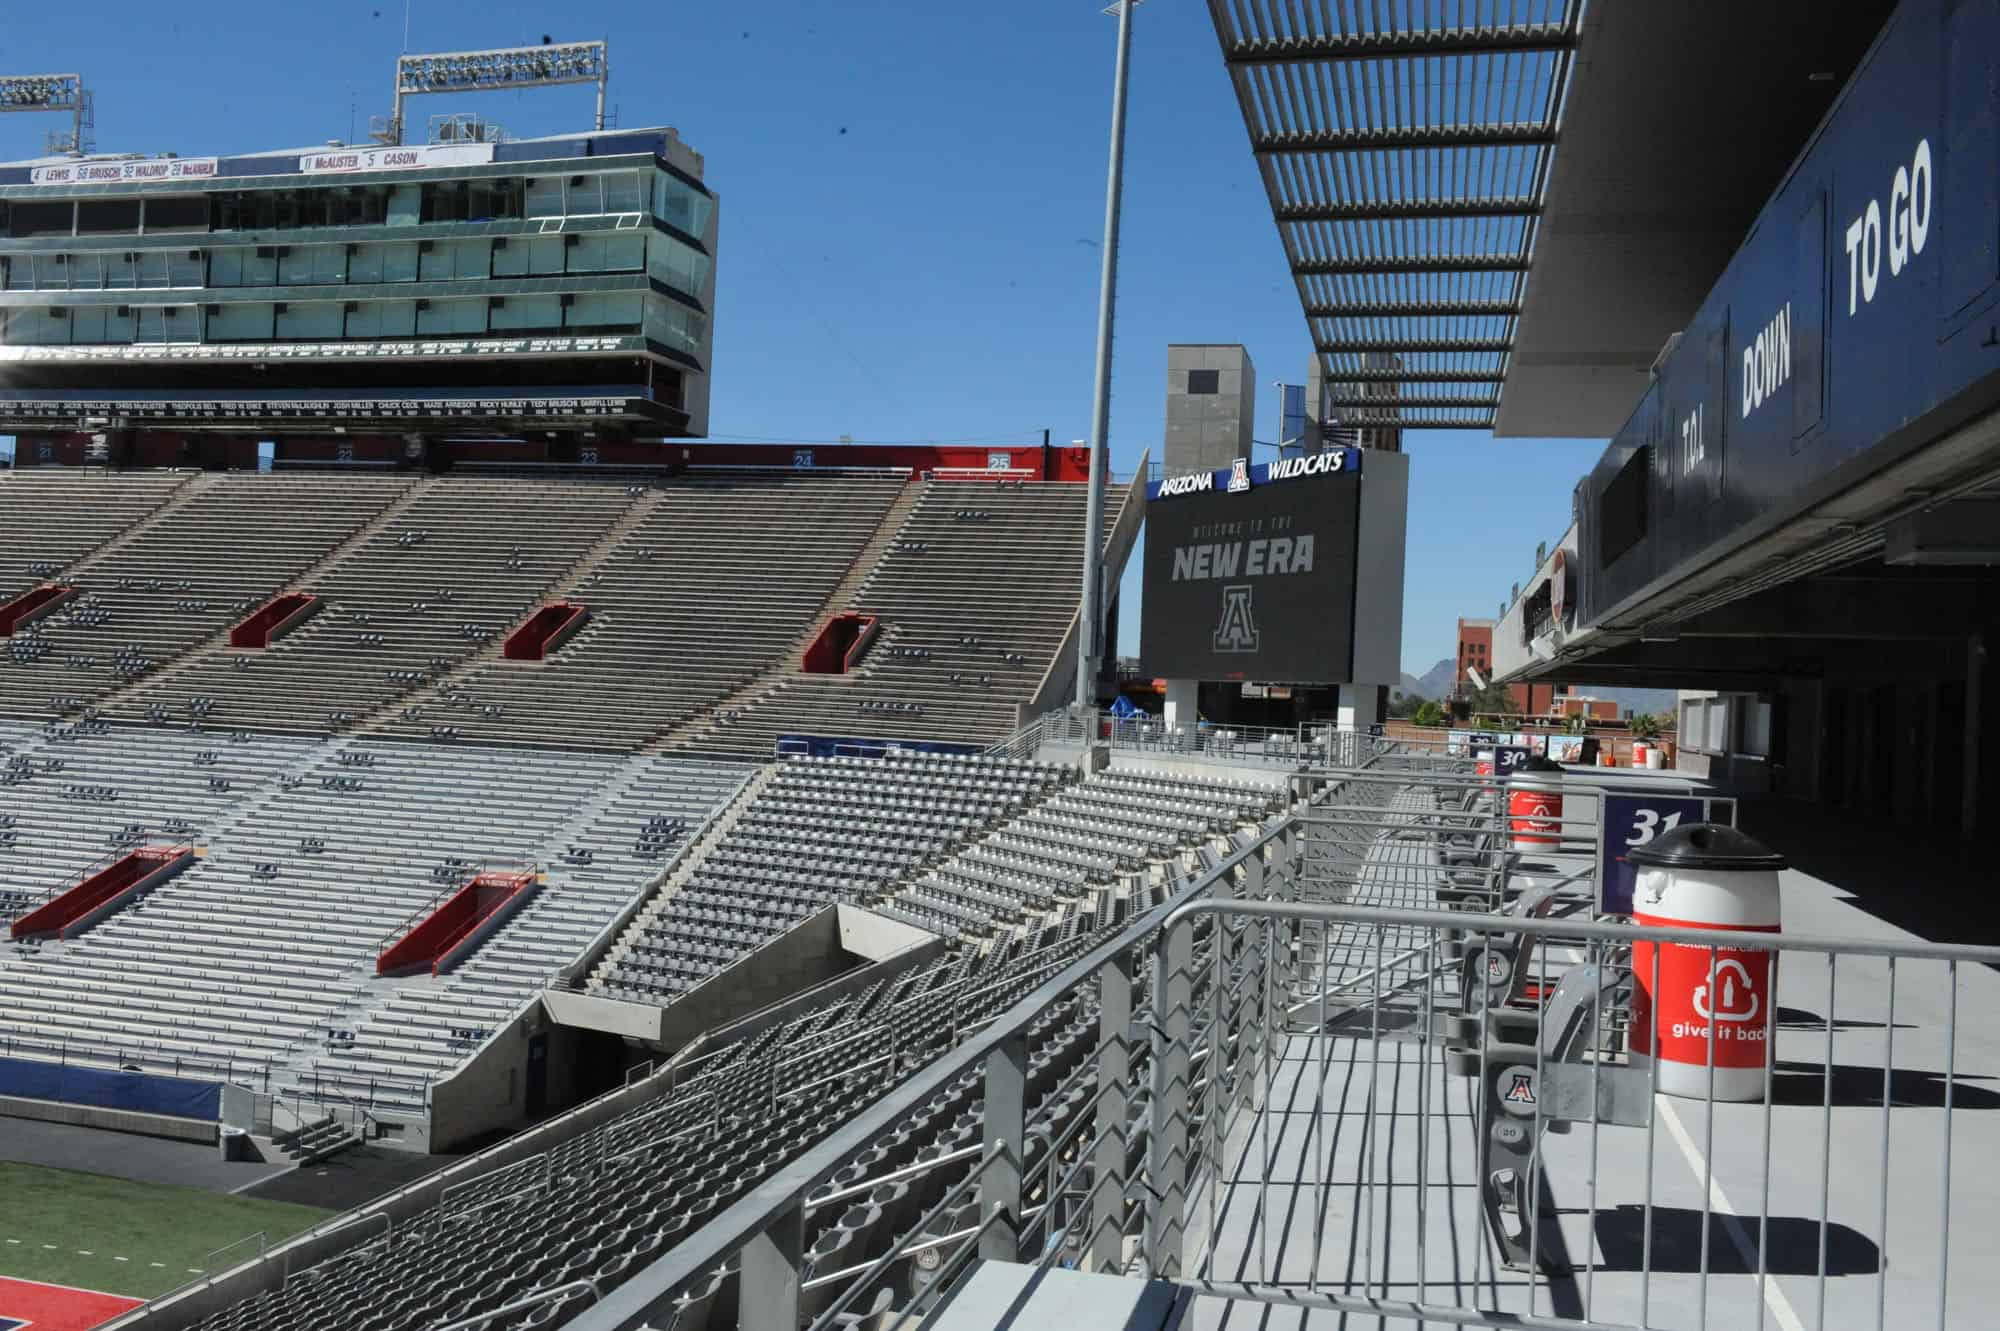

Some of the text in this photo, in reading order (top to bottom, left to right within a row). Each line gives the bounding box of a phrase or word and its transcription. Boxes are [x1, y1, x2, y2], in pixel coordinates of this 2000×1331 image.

[384, 152, 418, 164] CASON
[46, 168, 70, 181] LEWIS
[1846, 138, 1932, 316] TO GO
[1743, 301, 1790, 419] DOWN
[794, 455, 813, 466] 24
[990, 457, 1009, 470] 25
[1267, 451, 1344, 480] WILDCATS
[1158, 472, 1213, 497] ARIZONA
[1172, 533, 1315, 582] NEW ERA
[1212, 584, 1260, 653] A
[1672, 1021, 1710, 1038] give
[1718, 1024, 1731, 1040] it
